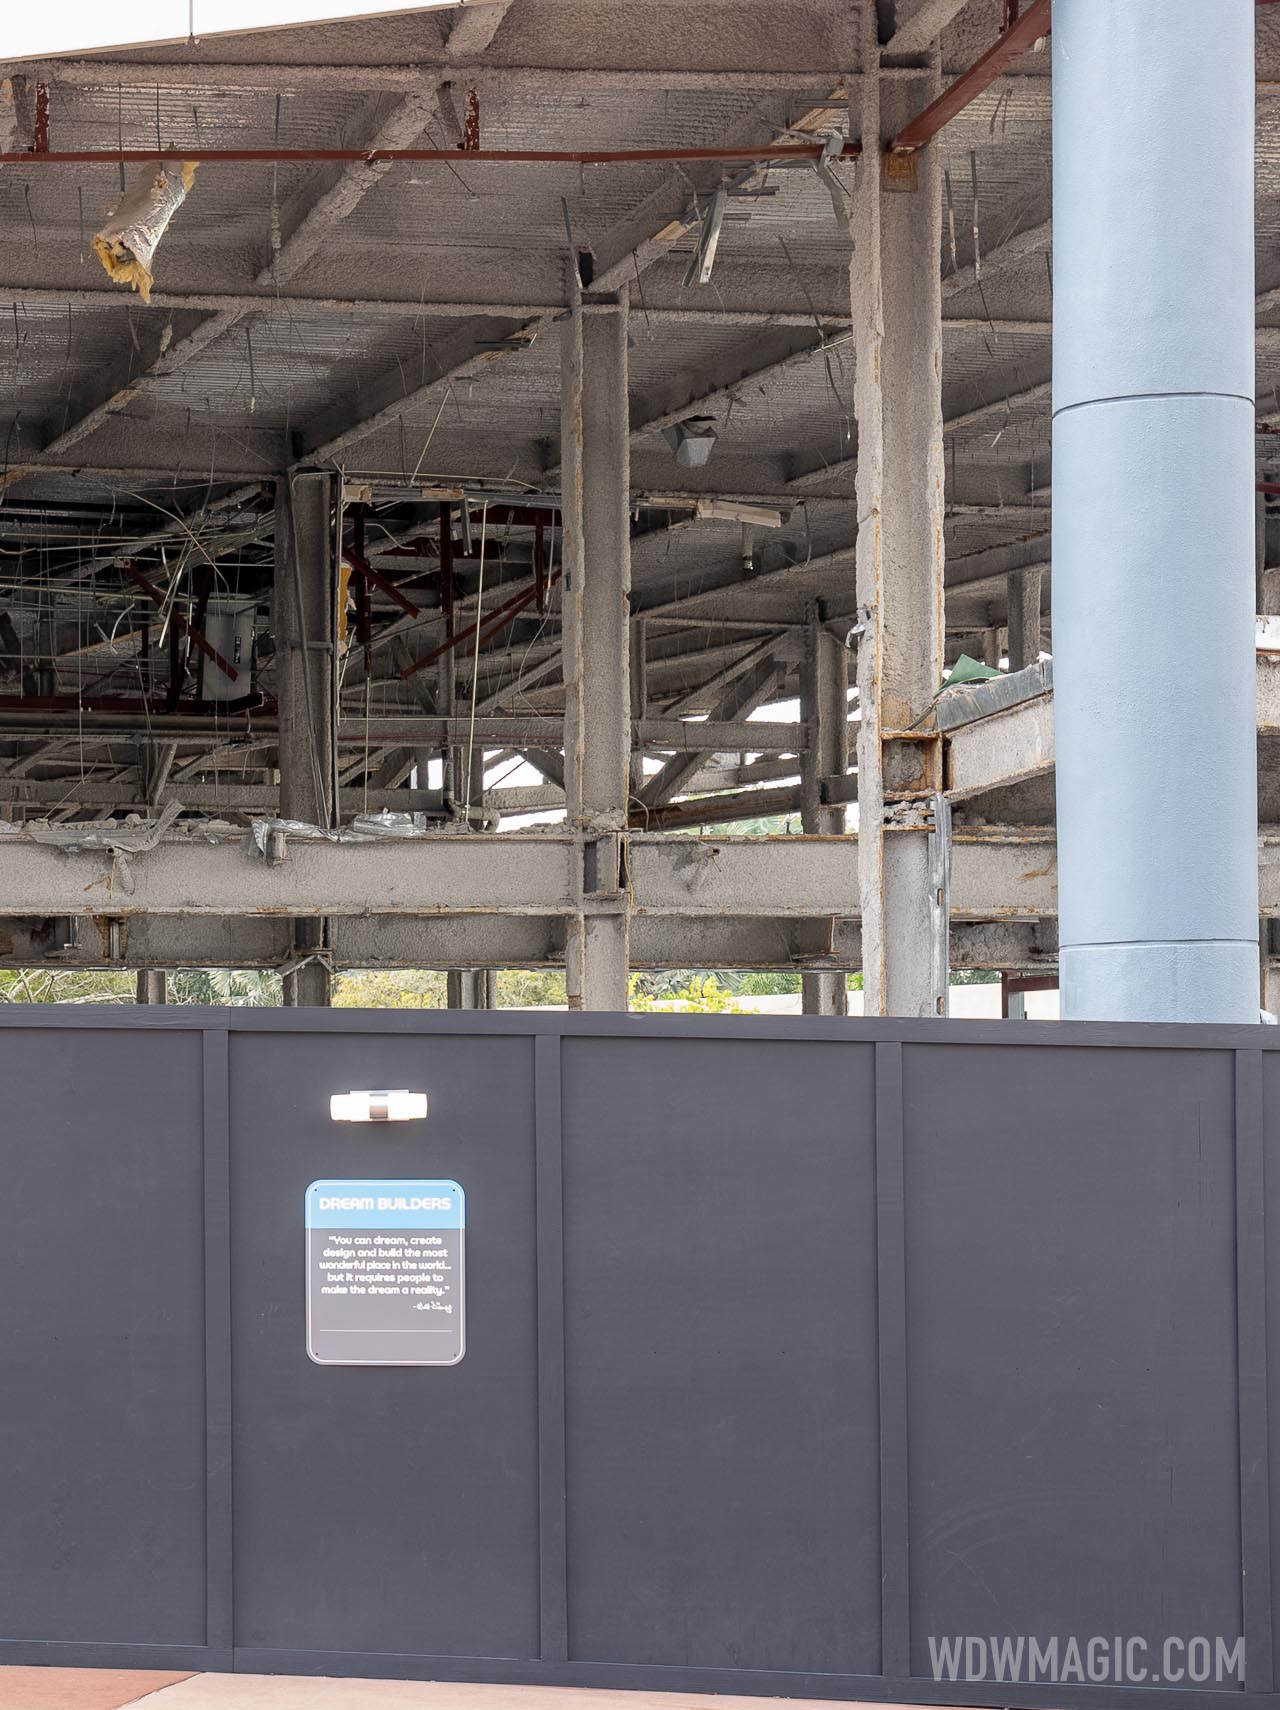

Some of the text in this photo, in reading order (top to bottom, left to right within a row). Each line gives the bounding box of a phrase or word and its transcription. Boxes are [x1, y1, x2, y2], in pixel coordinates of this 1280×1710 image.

[320, 1197, 452, 1210] DREAM BUILDERS
[354, 1237, 371, 1245] can
[373, 1236, 409, 1246] dream,
[410, 1236, 442, 1245] create
[323, 1248, 448, 1258] design and build the most
[320, 1261, 365, 1270] wonderful
[367, 1261, 390, 1271] place
[392, 1261, 400, 1269] in
[402, 1261, 417, 1269] the
[327, 1273, 443, 1284] but it requires people to
[321, 1286, 347, 1294] make
[349, 1286, 366, 1294] the
[368, 1286, 400, 1294] dream
